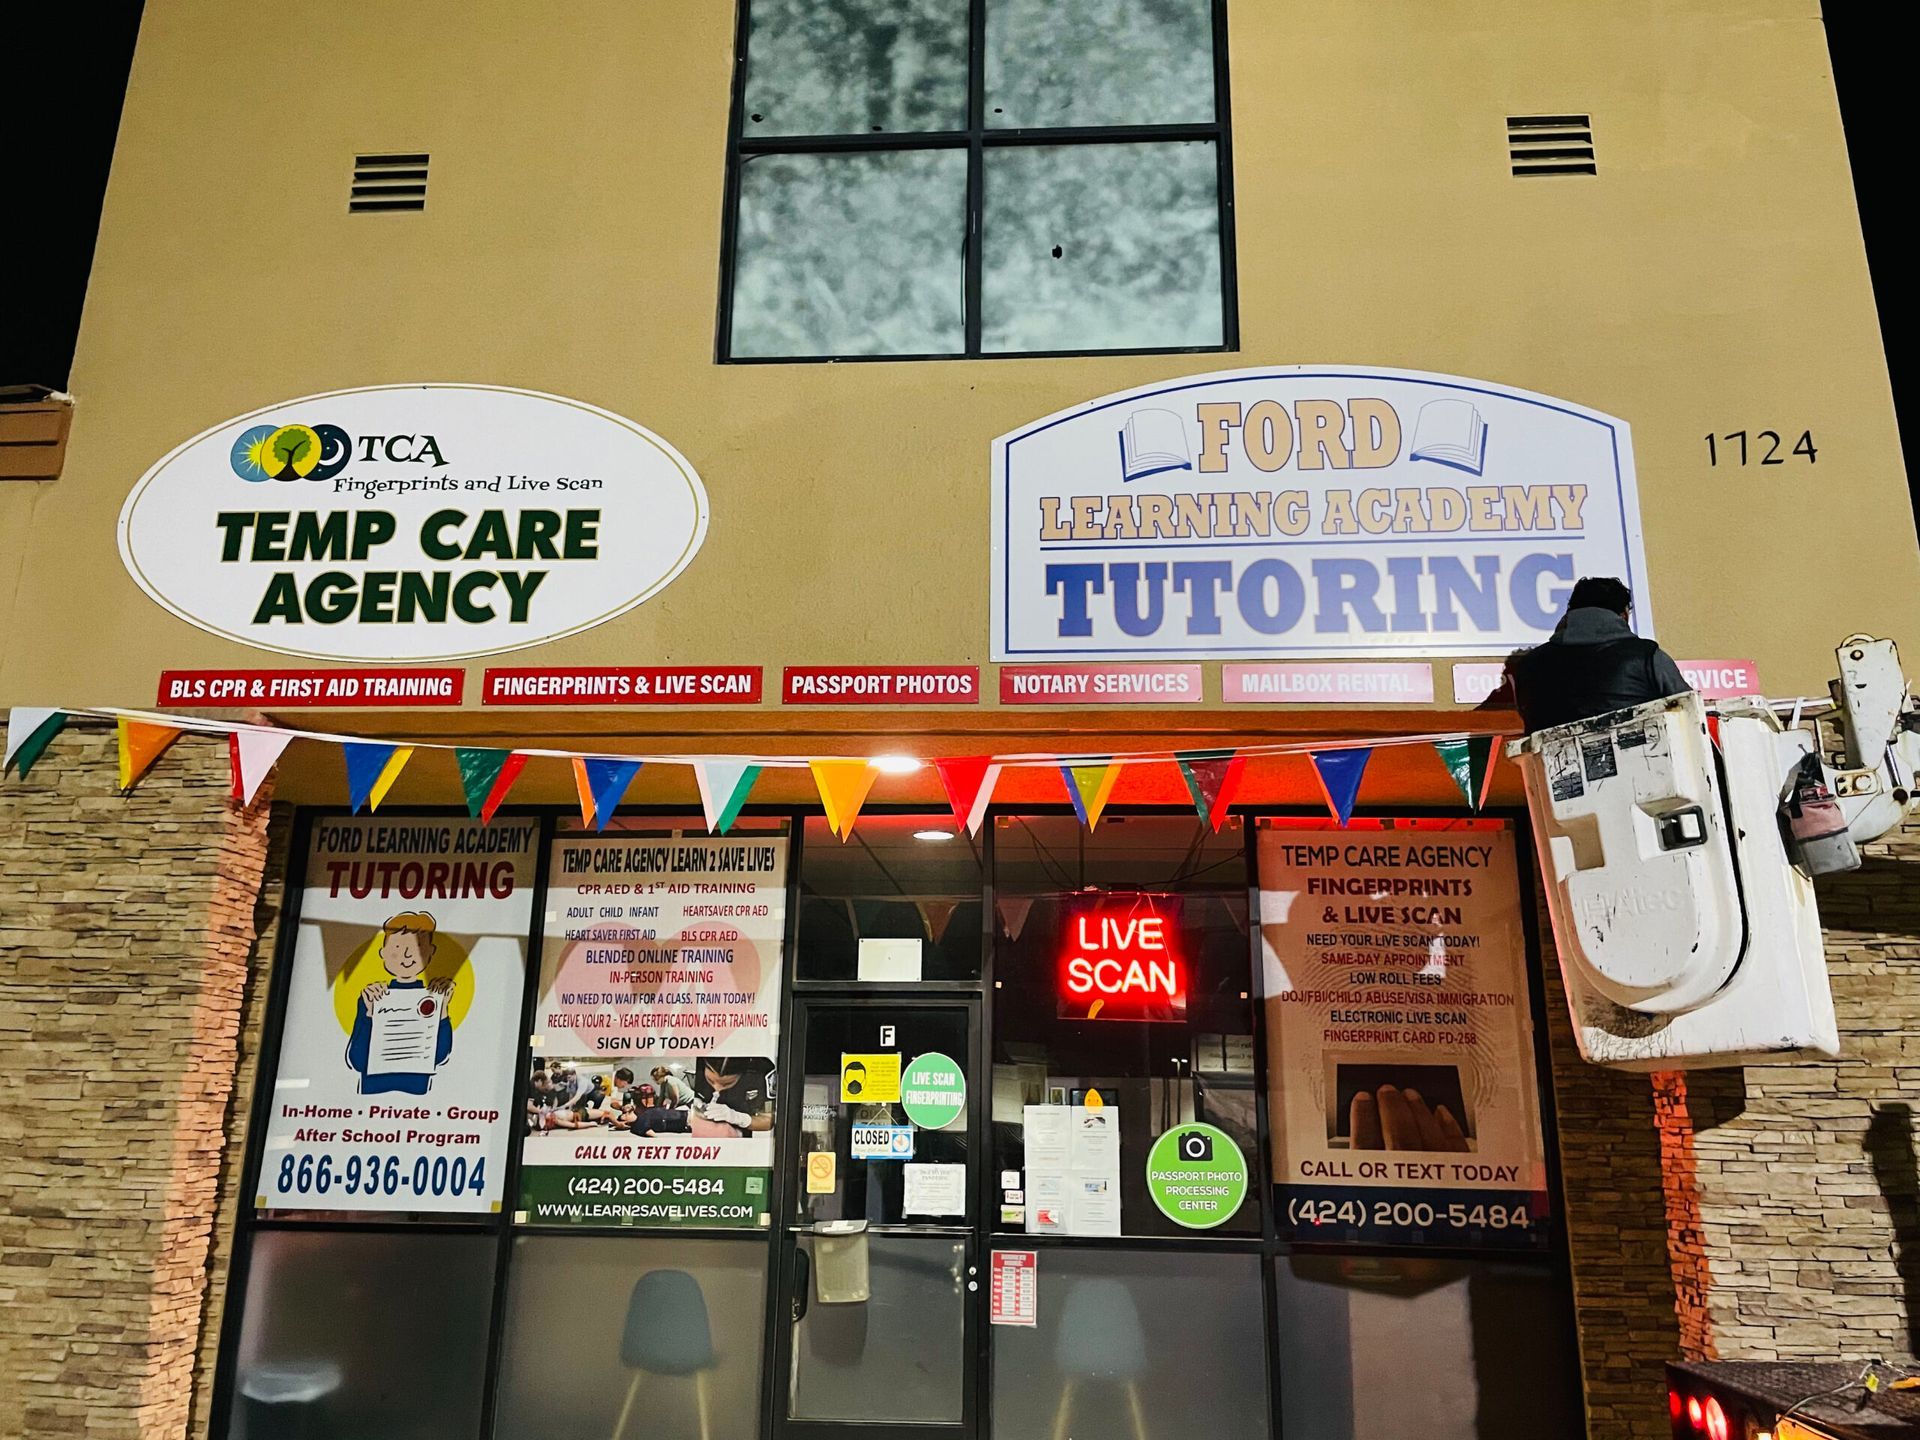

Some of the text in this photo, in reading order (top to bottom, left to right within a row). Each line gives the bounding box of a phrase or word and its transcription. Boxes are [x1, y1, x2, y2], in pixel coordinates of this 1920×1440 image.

[1197, 398, 1402, 473] FORD
[358, 435, 449, 467] TCA
[1705, 430, 1818, 466] 1724
[333, 474, 602, 499] Fingerprints and Live Scan
[1039, 484, 1587, 540] LEARNING ACADEMY
[216, 509, 601, 562] TEMP CARE
[252, 570, 548, 624] AGENCY
[1044, 553, 1576, 638] TUTORING
[493, 675, 751, 695] FINGERPRINTS & LIVE SCAN
[791, 675, 972, 693] PASSPORT PHOTOS
[1013, 673, 1188, 693] NOTARY SERVICES
[1242, 674, 1413, 692] MAILBOX RENTAL
[1682, 668, 1748, 689] RVICE
[170, 678, 452, 698] BLS CPR & FIRST AID TRAINING
[317, 826, 533, 854] FORD LEARNING ACADEMY
[563, 847, 775, 873] TEMP CARE AGENCY LEARN 2 SAVE LIVES
[1281, 845, 1492, 868] TEMP CARE AGENCY
[327, 862, 514, 899] TUTORING
[577, 884, 600, 894] CPR
[606, 884, 630, 894] AED
[634, 884, 643, 894] &
[668, 883, 690, 893] AID
[694, 883, 756, 893] TRAINING
[1307, 877, 1472, 896] FINGERPRINTS
[567, 907, 659, 917] ADULT CHILD INFANT
[683, 905, 768, 917] HEARTSAVER CPR AED
[1322, 906, 1461, 924] & LIVE SCAN
[565, 930, 656, 941] HEART SAVER FIRST AID
[681, 931, 738, 941] BLS CPR AED
[1078, 916, 1164, 950] LIVE
[1307, 934, 1480, 948] NEED YOUR LIVE SCAN TODAY!
[586, 950, 733, 963] BLENDED ONLINE TRAINING
[1321, 952, 1464, 966] SAME-DAY APPOINTMENT
[610, 971, 713, 983] IN-PERSON TRAINING
[1067, 958, 1176, 995] SCAN
[1350, 973, 1441, 985] LOW ROLL FEES
[562, 993, 755, 1004] NO NEED TO WAIT FOR A CLASS. TRAIN TODAY!
[1437, 993, 1514, 1006] IMMIGRATION
[549, 1015, 580, 1027] RECEIVE
[582, 1014, 605, 1027] YOUR
[620, 1014, 639, 1027] YEAR
[641, 1014, 700, 1027] CERTIFICATION
[702, 1014, 726, 1027] AFTER
[729, 1014, 768, 1027] TRAINING
[1331, 1010, 1466, 1025] ELECTRONIC LIVE SCAN
[597, 1037, 714, 1049] SIGN UP TODAY!
[883, 1028, 892, 1044] F
[1324, 1030, 1476, 1045] FINGERPRINT CARD FD-258
[912, 1072, 955, 1085] LIVE SCAN
[906, 1091, 962, 1105] FINGERPRINTING
[282, 1105, 499, 1123] In-Home Private Group
[294, 1129, 480, 1146] After School Program
[854, 1130, 889, 1145] CLOSED
[575, 1146, 720, 1160] CALL OR TEXT TODAY
[278, 1154, 485, 1196] 866-936-0004
[1152, 1171, 1242, 1181] PASSPORT PHOTO
[1300, 1160, 1519, 1182] CALL OR TEXT TODAY
[568, 1177, 724, 1196] (424) 200-5484
[1166, 1186, 1229, 1195] PROCESSING
[538, 1205, 752, 1217] WWW.LEARN2SAVELIVES.COM
[1179, 1201, 1217, 1210] CENTER
[1288, 1198, 1529, 1229] (424) 200-5484
